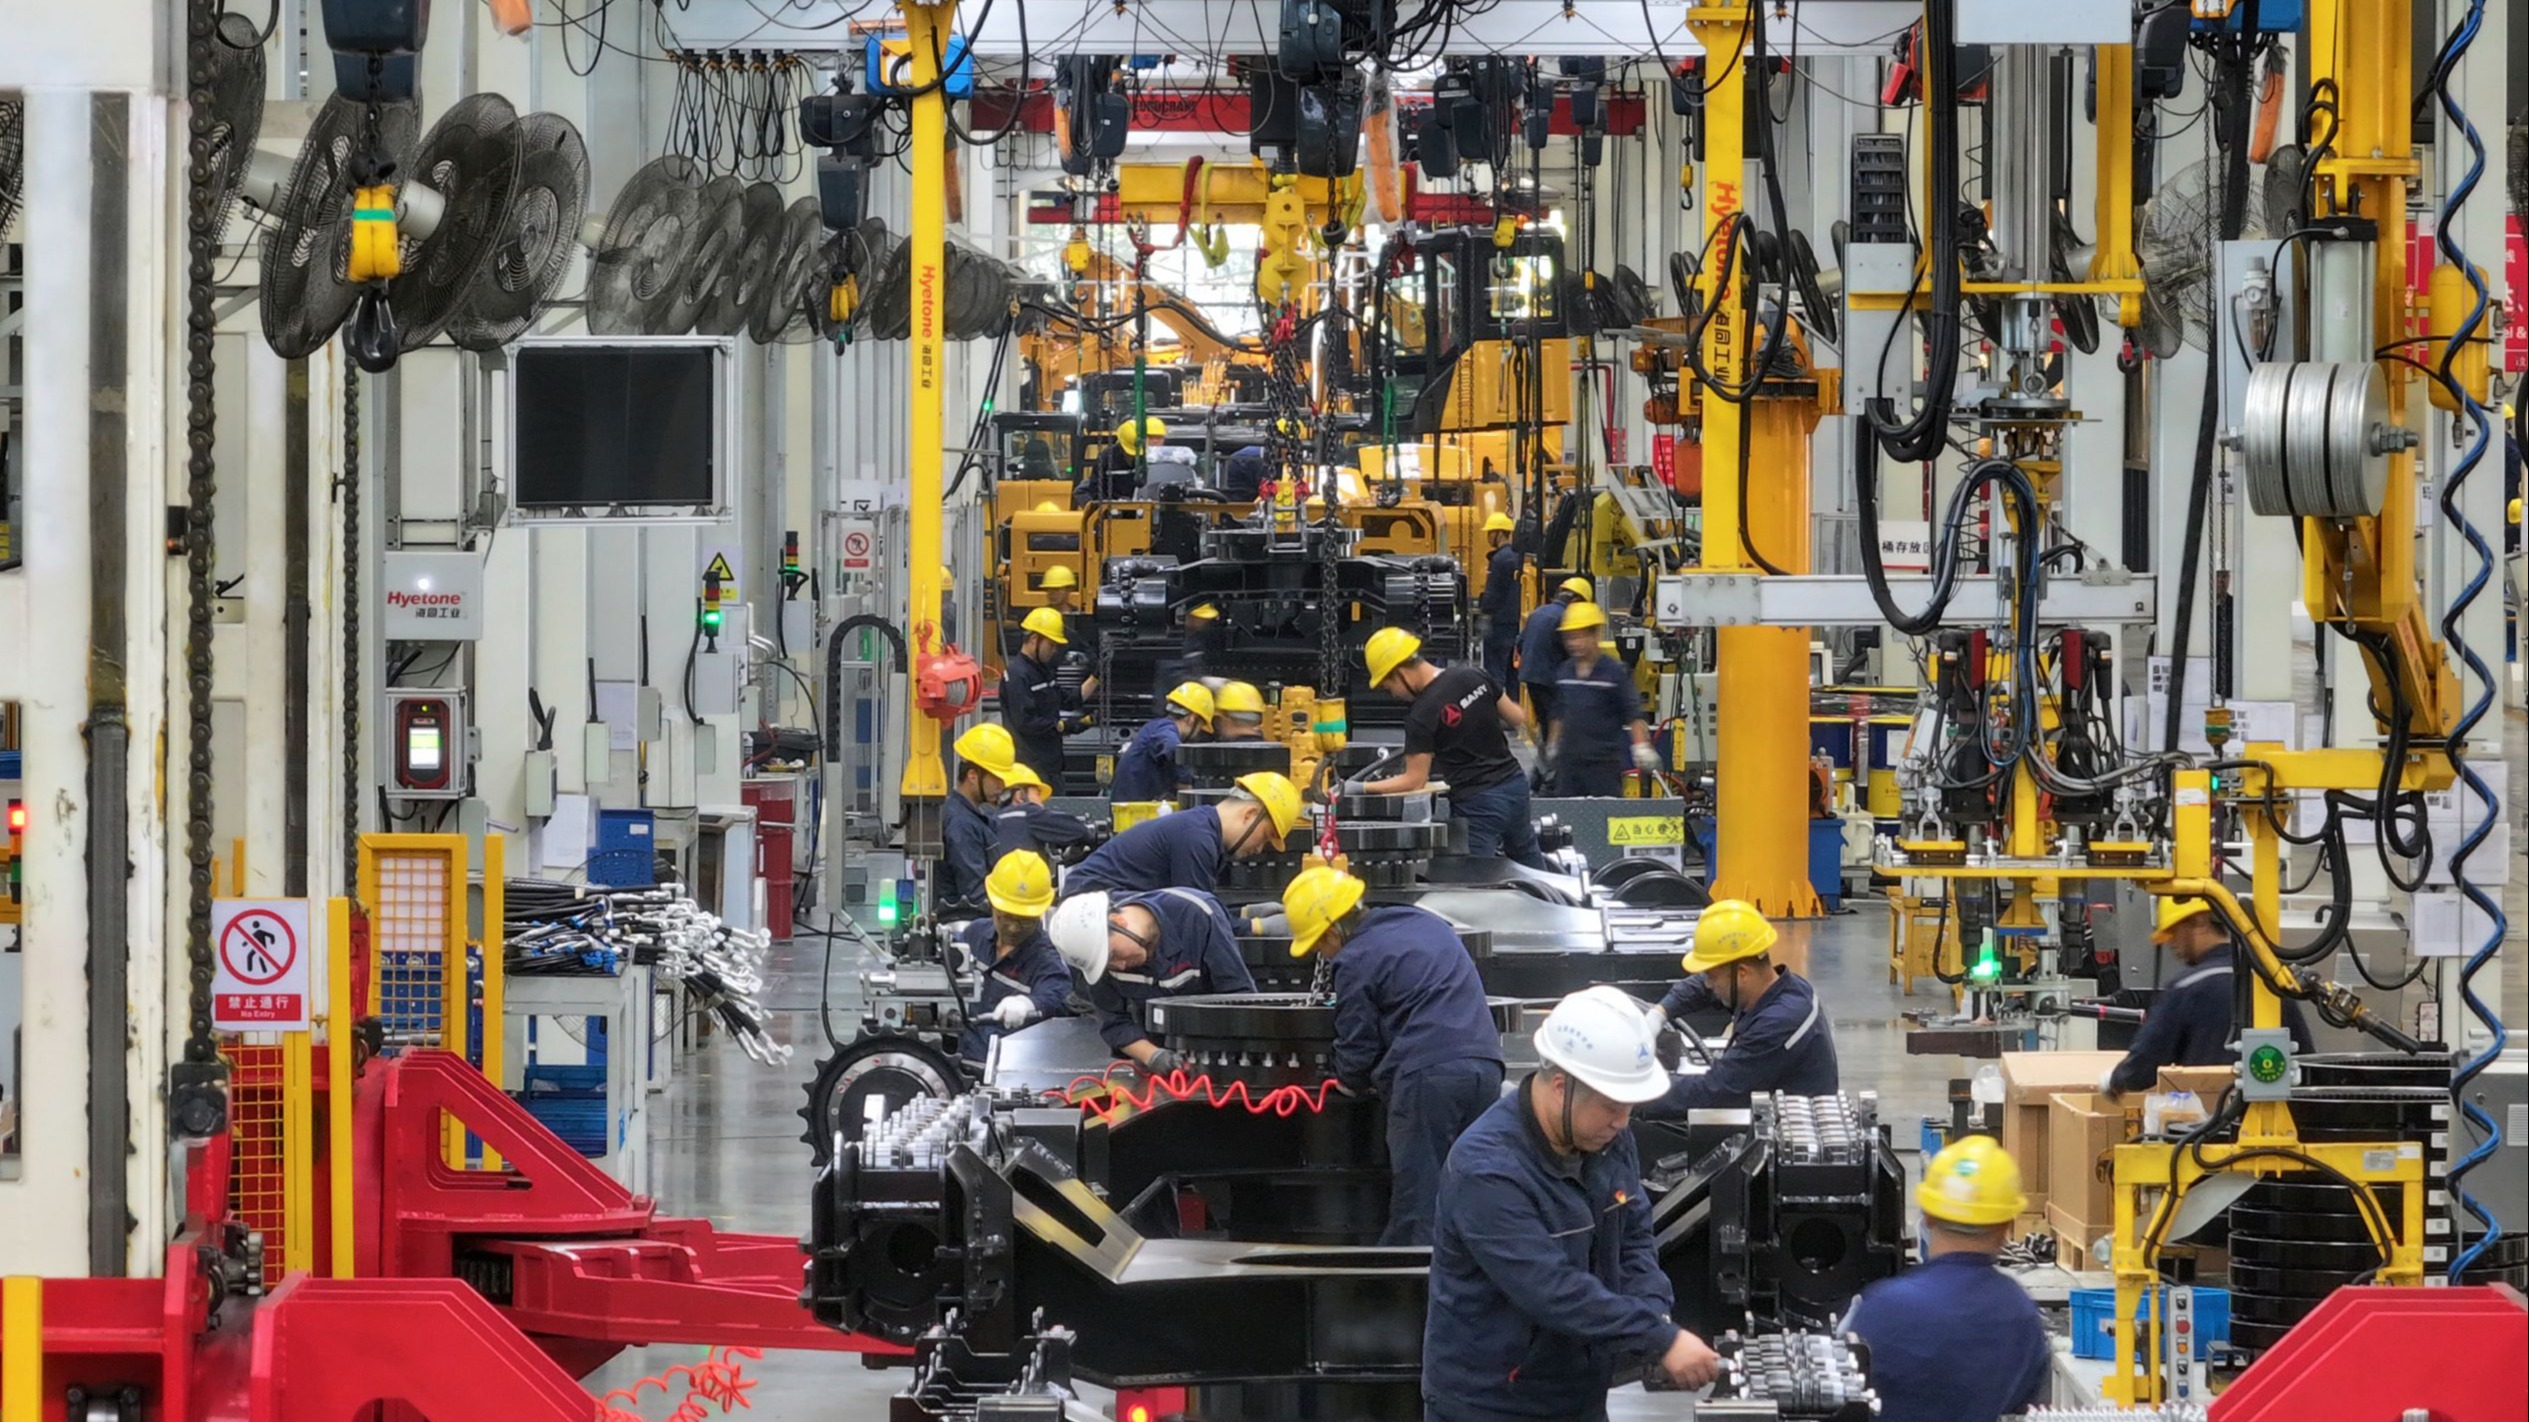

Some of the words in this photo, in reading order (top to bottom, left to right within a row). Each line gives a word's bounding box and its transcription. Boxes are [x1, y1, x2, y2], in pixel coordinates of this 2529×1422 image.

[919, 265, 935, 338] Hyetone
[387, 591, 461, 608] Hyetone
[1460, 684, 1487, 709] SANY
[228, 996, 289, 1009] 禁止通行
[241, 1010, 252, 1018] No
[254, 1010, 276, 1019] Entry
